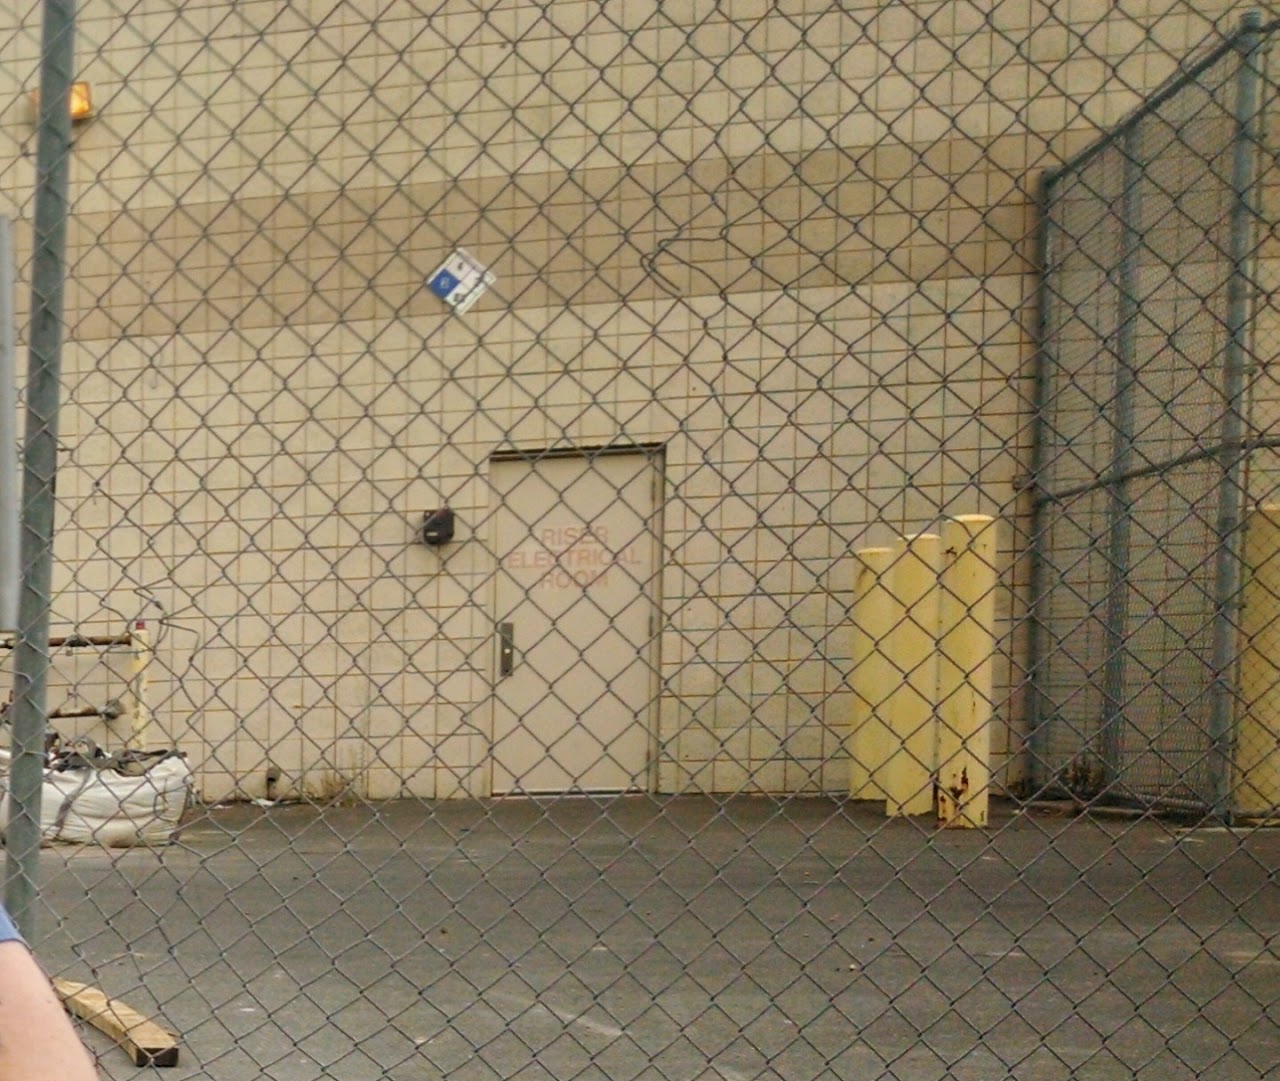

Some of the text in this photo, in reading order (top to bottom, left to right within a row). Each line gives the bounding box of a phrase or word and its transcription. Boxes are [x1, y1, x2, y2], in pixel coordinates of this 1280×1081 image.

[542, 526, 609, 545] RISER
[507, 548, 643, 568] ELECTRICAL
[541, 570, 609, 588] ROOM
